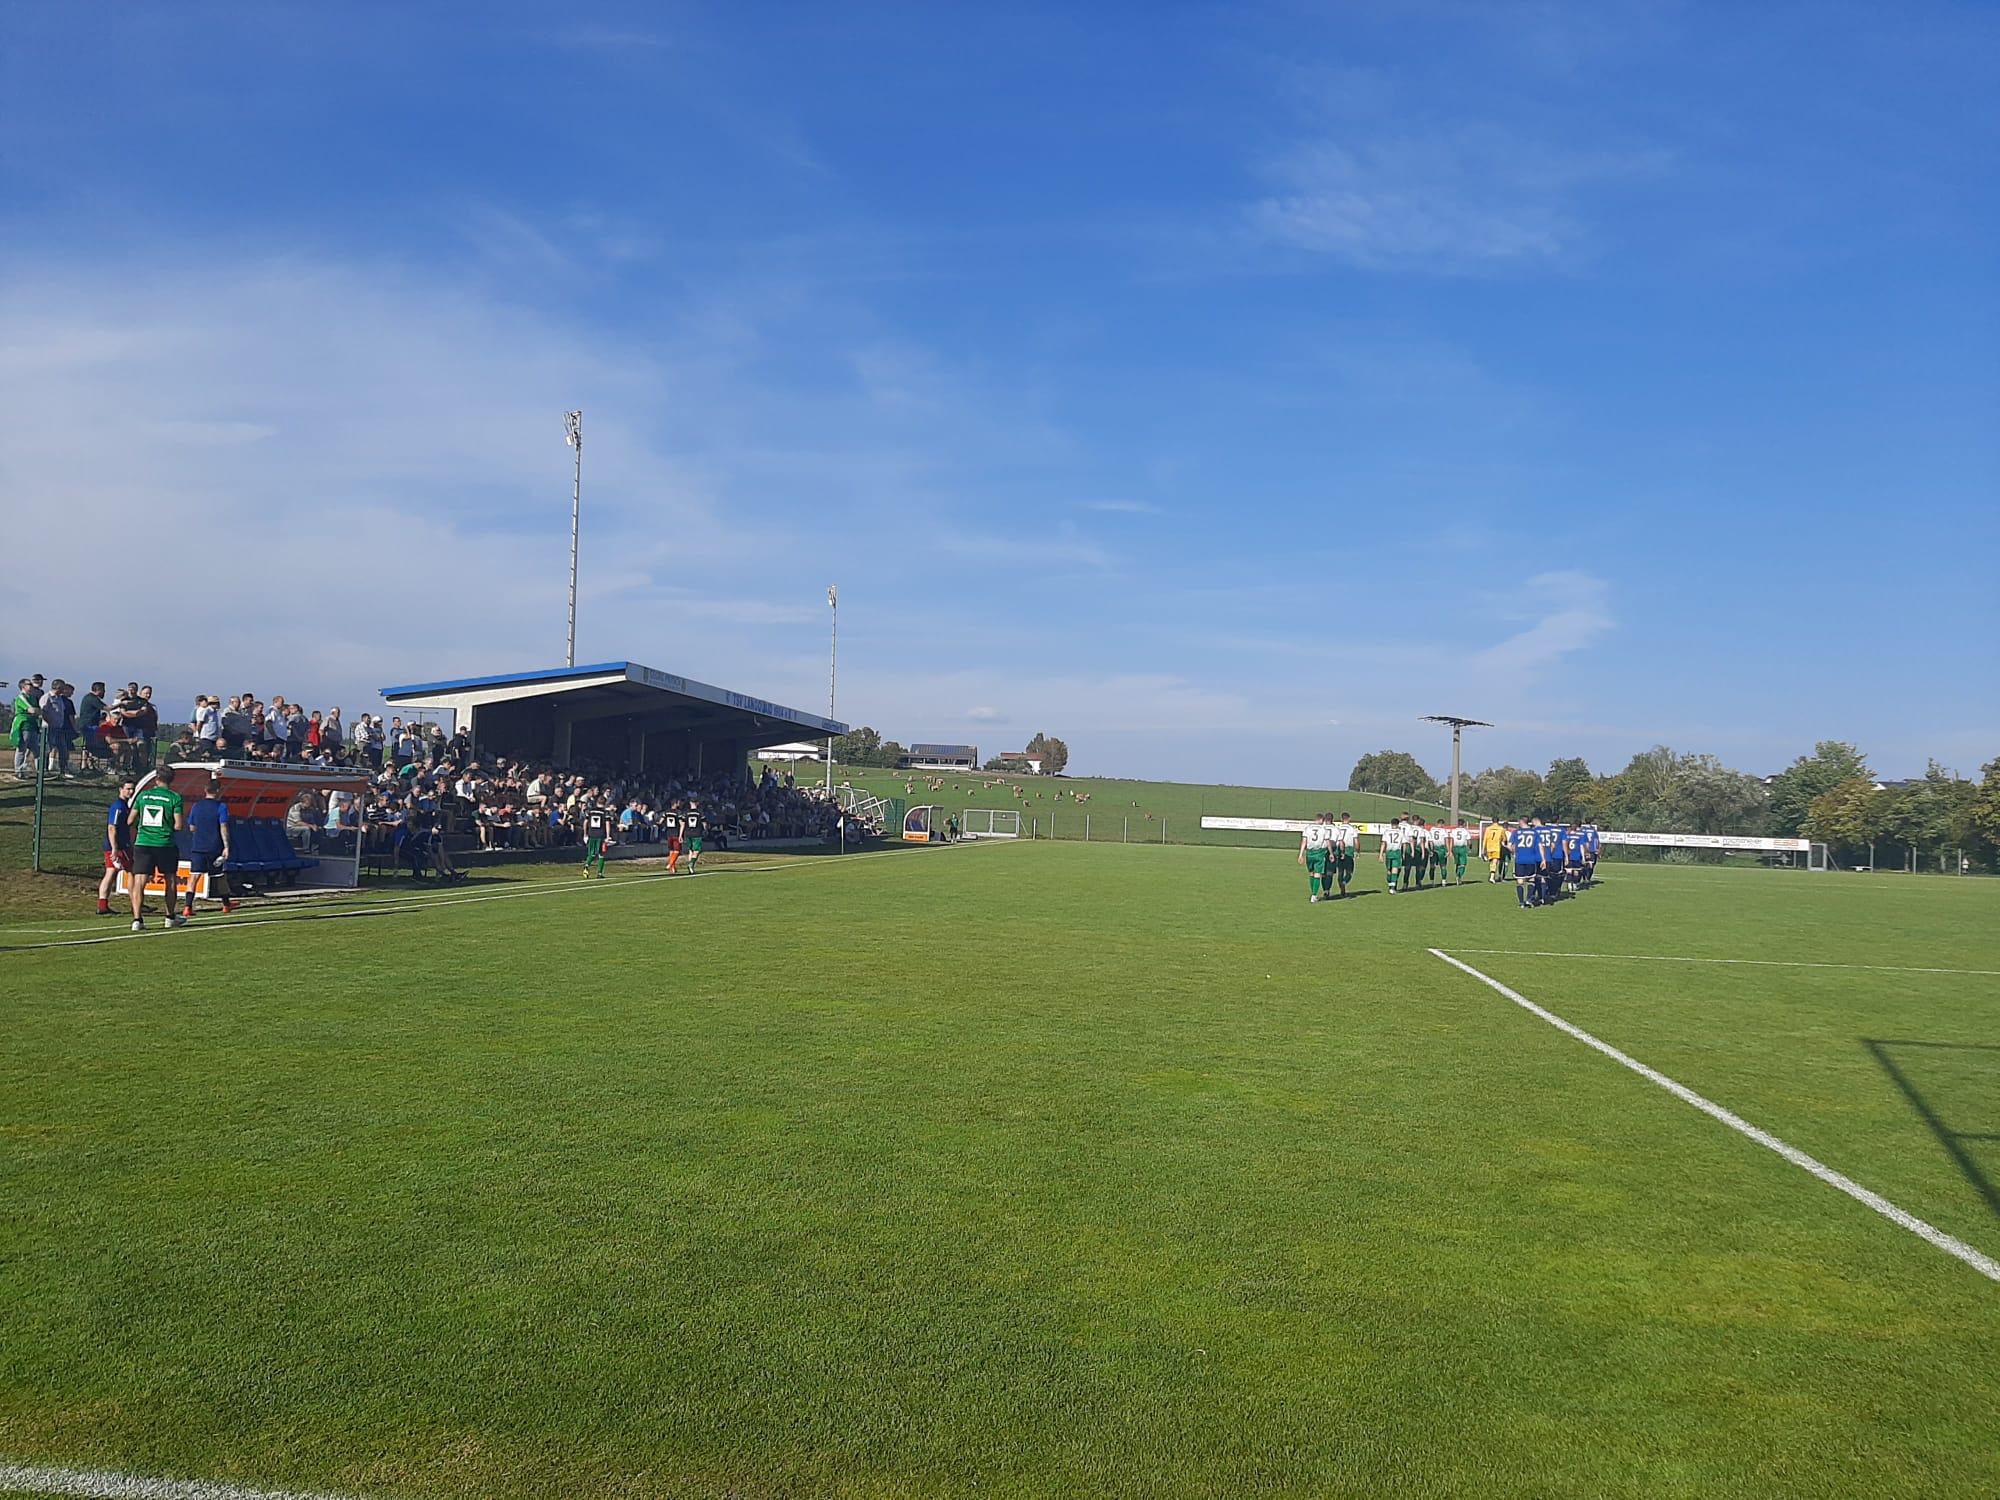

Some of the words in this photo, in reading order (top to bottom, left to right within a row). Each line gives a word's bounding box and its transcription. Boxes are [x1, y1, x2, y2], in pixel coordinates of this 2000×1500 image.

[1312, 829, 1319, 842] 3
[1389, 832, 1400, 844] 12
[1434, 831, 1440, 841] 6
[1456, 831, 1463, 841] 5
[1518, 834, 1534, 848] 20
[1568, 839, 1576, 850] 6
